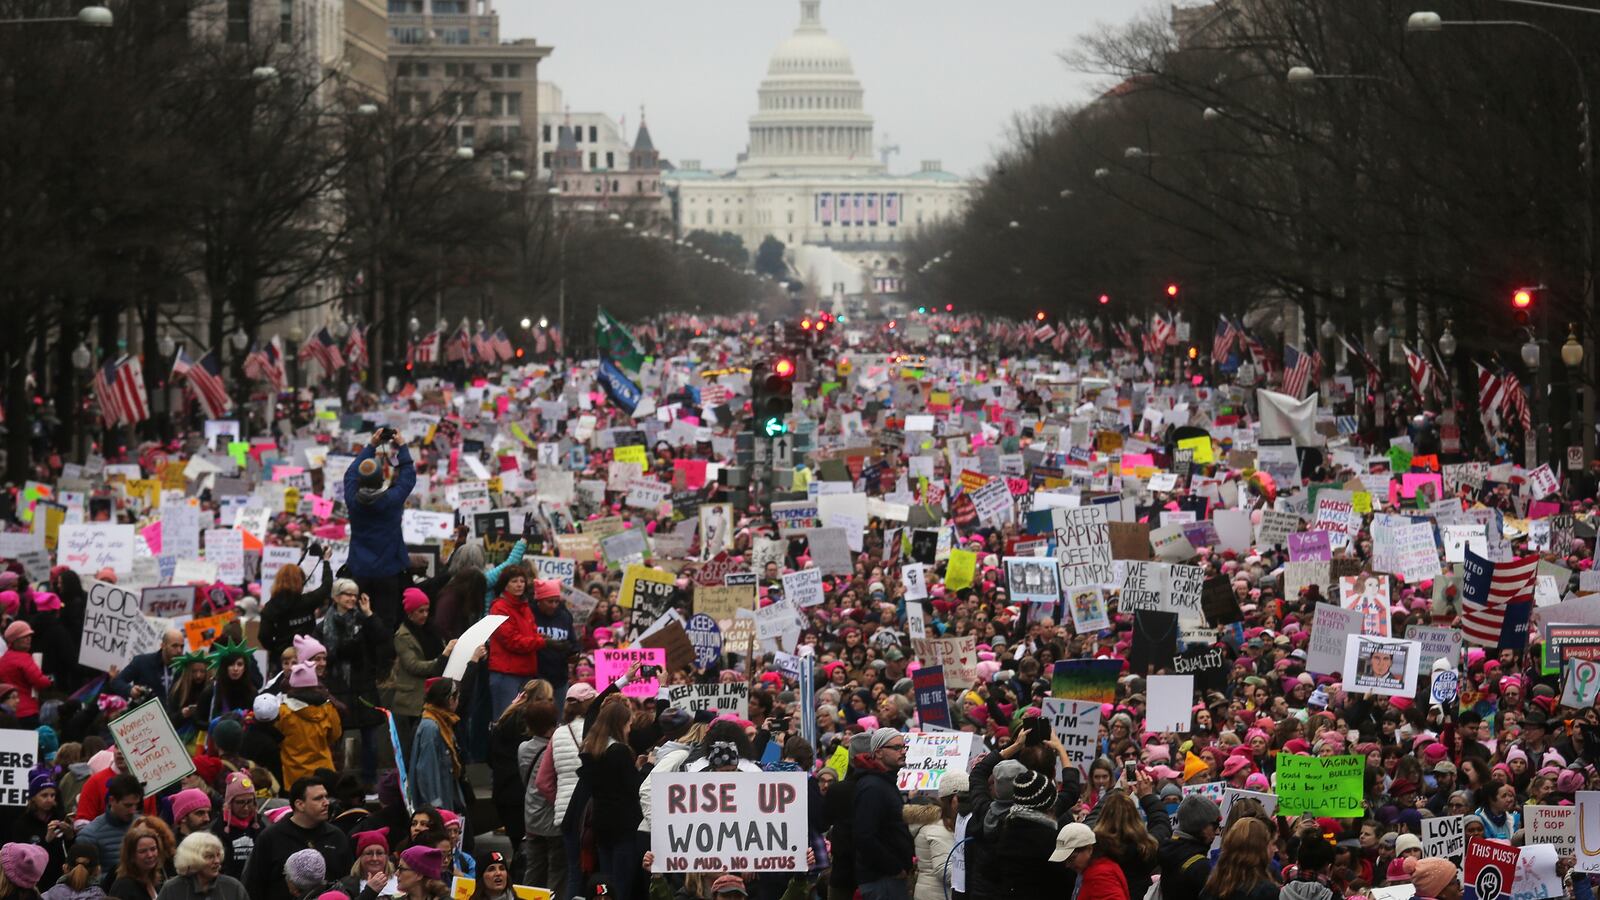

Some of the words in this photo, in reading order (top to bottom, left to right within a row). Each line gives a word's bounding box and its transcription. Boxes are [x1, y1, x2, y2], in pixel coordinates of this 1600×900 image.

[1320, 500, 1352, 511] DIVERSITY
[1064, 508, 1101, 526] KEEP
[1319, 511, 1349, 521] MAKES
[1316, 520, 1348, 534] AMERICA
[1055, 525, 1110, 549] RAPISTS
[1061, 549, 1088, 565] OFF
[1091, 545, 1110, 563] MY
[537, 560, 574, 575] TCHES
[1126, 561, 1149, 578] WE
[1170, 564, 1204, 581] NEVER
[1465, 560, 1483, 576] ITED
[1062, 565, 1115, 588] CAMPUS
[1123, 577, 1146, 590] ARE
[635, 580, 674, 597] STOP
[90, 583, 139, 619] GOD
[1122, 591, 1161, 605] CITIZENS
[1170, 593, 1200, 611] BACK
[690, 615, 715, 631] KEEP
[736, 618, 753, 630] MY
[84, 629, 129, 657] TRUM
[604, 651, 655, 661] WOMENS
[694, 647, 718, 666] EGAL
[670, 686, 694, 703] KEEP
[696, 684, 720, 698] YOUR
[724, 682, 748, 699] LAWS
[690, 699, 710, 712] OFF
[717, 697, 739, 710] OUR
[1054, 715, 1078, 730] I'M
[1059, 735, 1088, 747] ITH
[1067, 750, 1085, 762] ER
[1320, 757, 1359, 769] VAGINA
[1328, 768, 1362, 780] BULLETS
[1304, 782, 1315, 791] be
[668, 782, 738, 815] RISE
[758, 782, 797, 814] UP
[1277, 796, 1359, 811] REGULATED
[1429, 818, 1463, 839] LOVE
[1544, 820, 1565, 830] GOP
[667, 820, 798, 853] WOMAN.
[1532, 835, 1564, 845] HANDS
[1424, 841, 1443, 858] NOT
[1446, 837, 1463, 853] HATE
[1471, 842, 1491, 859] THIS
[1492, 846, 1519, 865] PUSSY
[666, 856, 688, 871] NO
[694, 856, 728, 872] MUD,
[731, 856, 749, 870] NO
[754, 855, 796, 870] LOTUS
